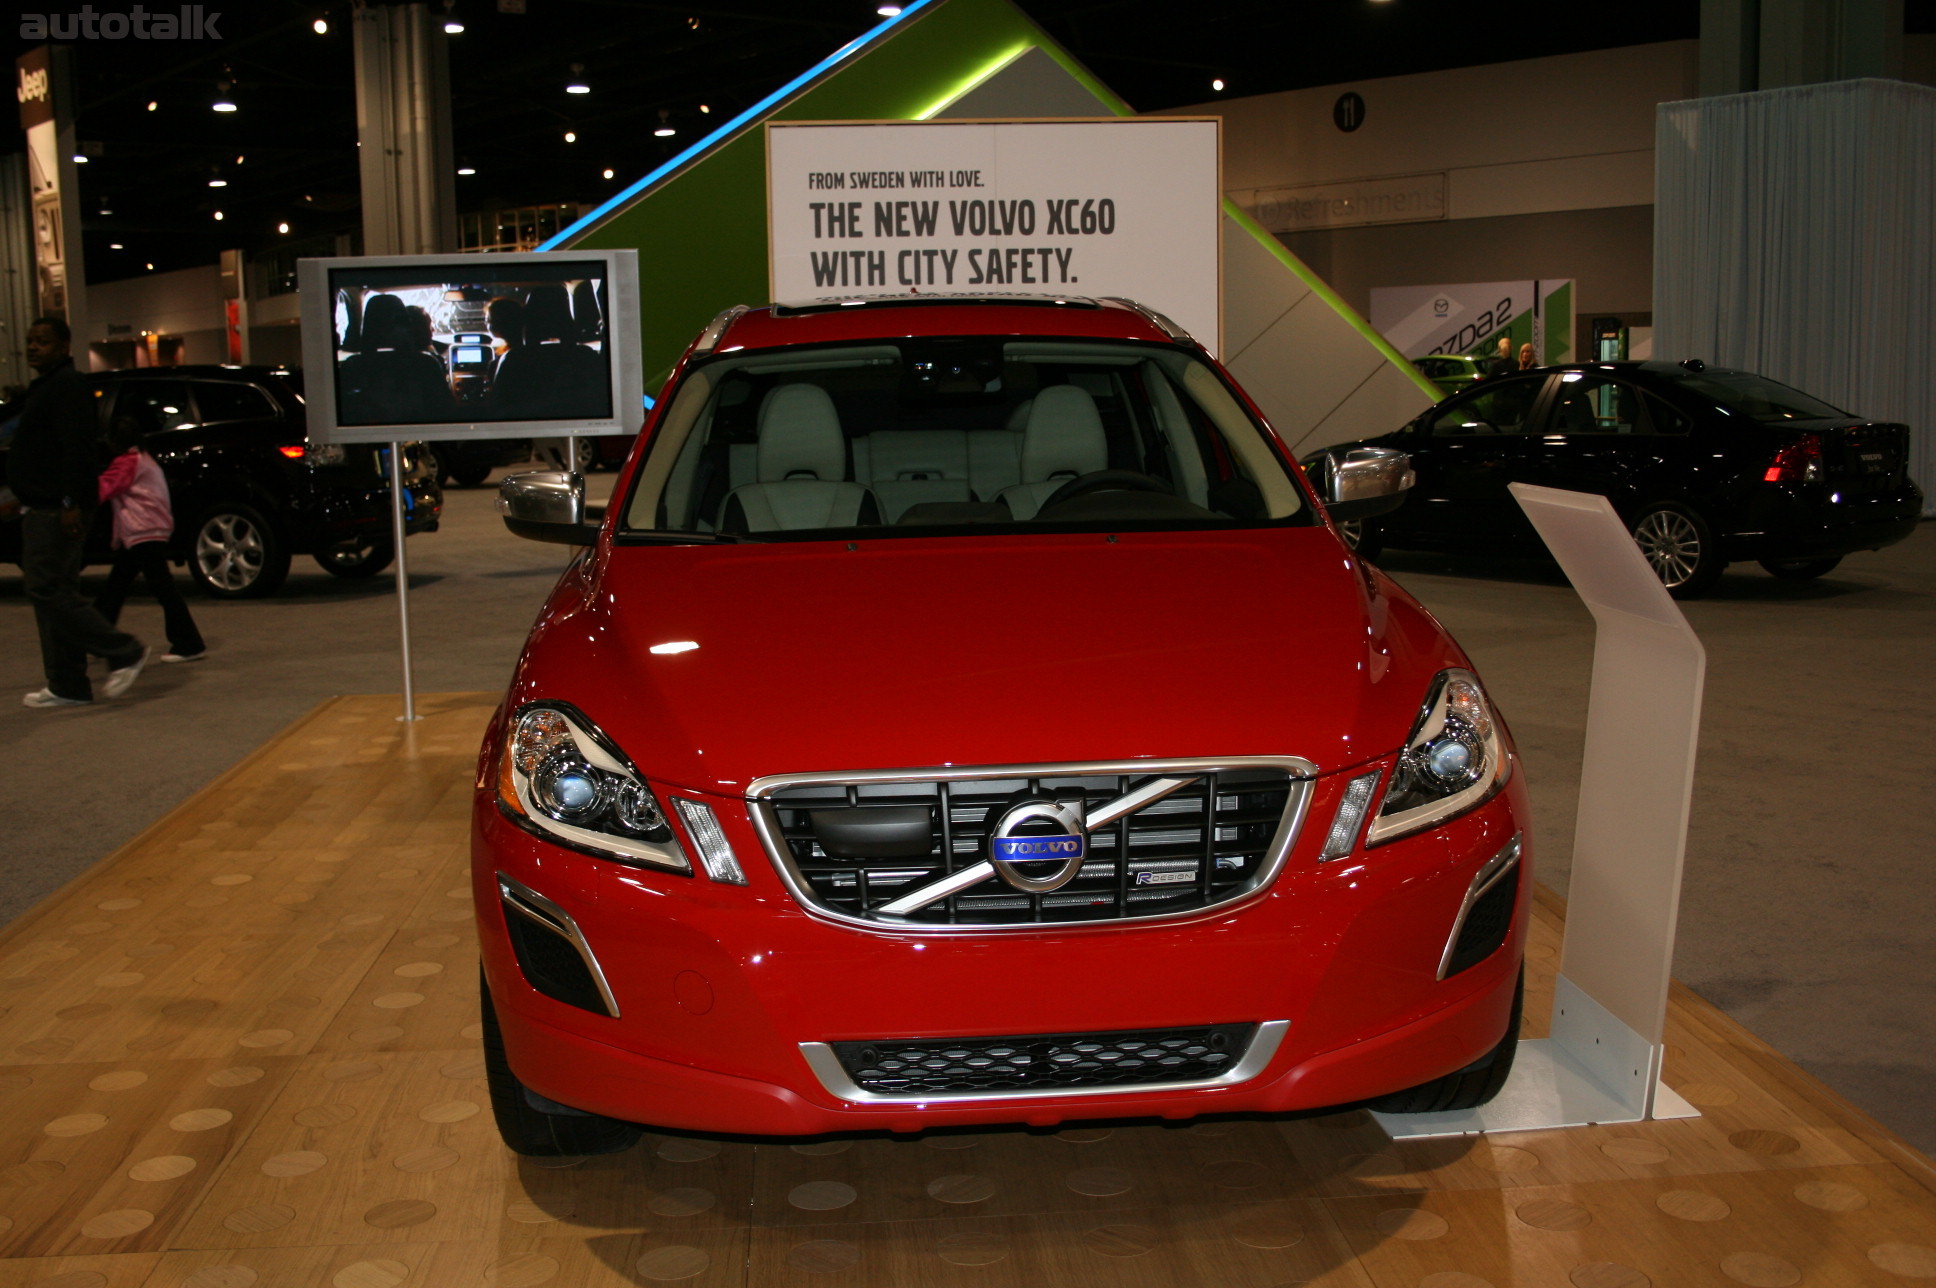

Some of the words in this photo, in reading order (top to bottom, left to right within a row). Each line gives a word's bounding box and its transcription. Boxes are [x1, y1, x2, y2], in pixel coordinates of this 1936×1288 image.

[17, 67, 48, 103] Jeep
[808, 172, 845, 189] FROM
[849, 171, 905, 189] SWEDEN
[909, 170, 945, 188] WITH
[949, 170, 985, 187] LOVE.
[808, 202, 863, 238] THE
[874, 201, 939, 237] NEW
[949, 199, 1035, 236] VOLVO
[1046, 198, 1115, 235] XC60
[810, 250, 886, 287] WITH
[897, 249, 958, 286] CITY
[968, 247, 1078, 284] SAFETY.
[1000, 840, 1078, 855] VOLVO
